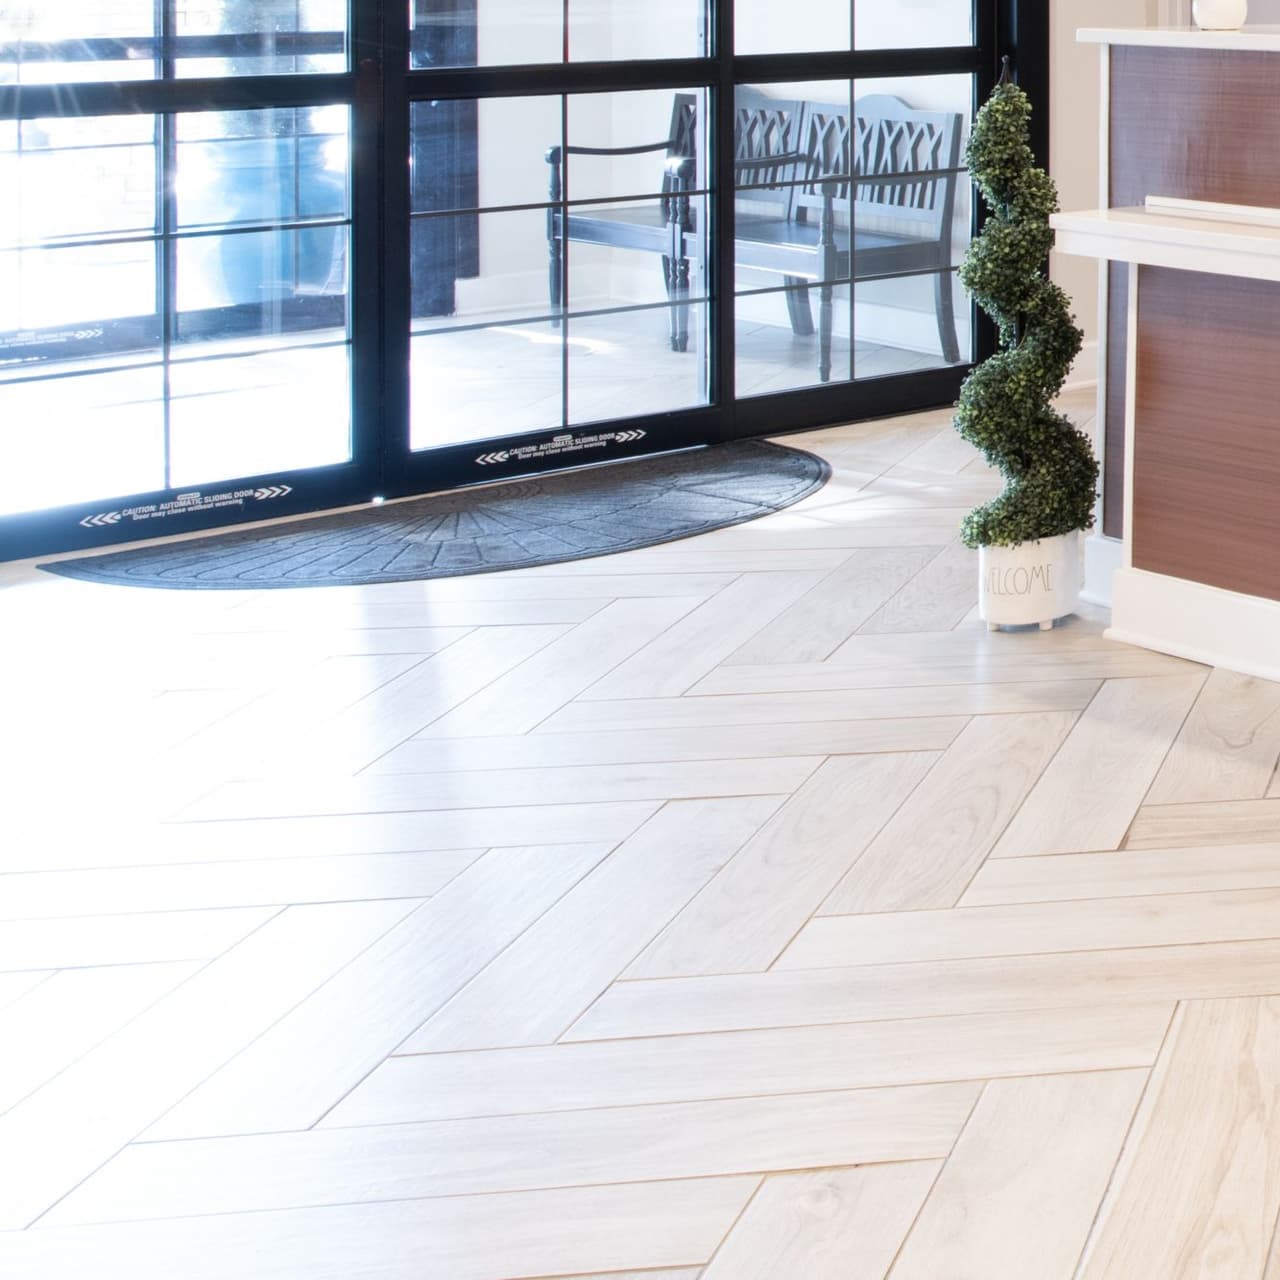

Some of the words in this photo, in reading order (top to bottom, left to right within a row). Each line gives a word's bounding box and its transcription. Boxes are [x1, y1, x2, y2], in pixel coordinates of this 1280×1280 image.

[539, 439, 574, 450] AUTOMATIC
[575, 435, 598, 445] SLIDING
[122, 505, 157, 517] CAUTION:
[160, 498, 202, 510] AUTOMATIC
[204, 493, 233, 504] SLIDING
[234, 489, 254, 498] DOOR
[188, 504, 214, 512] without
[215, 499, 243, 508] warning
